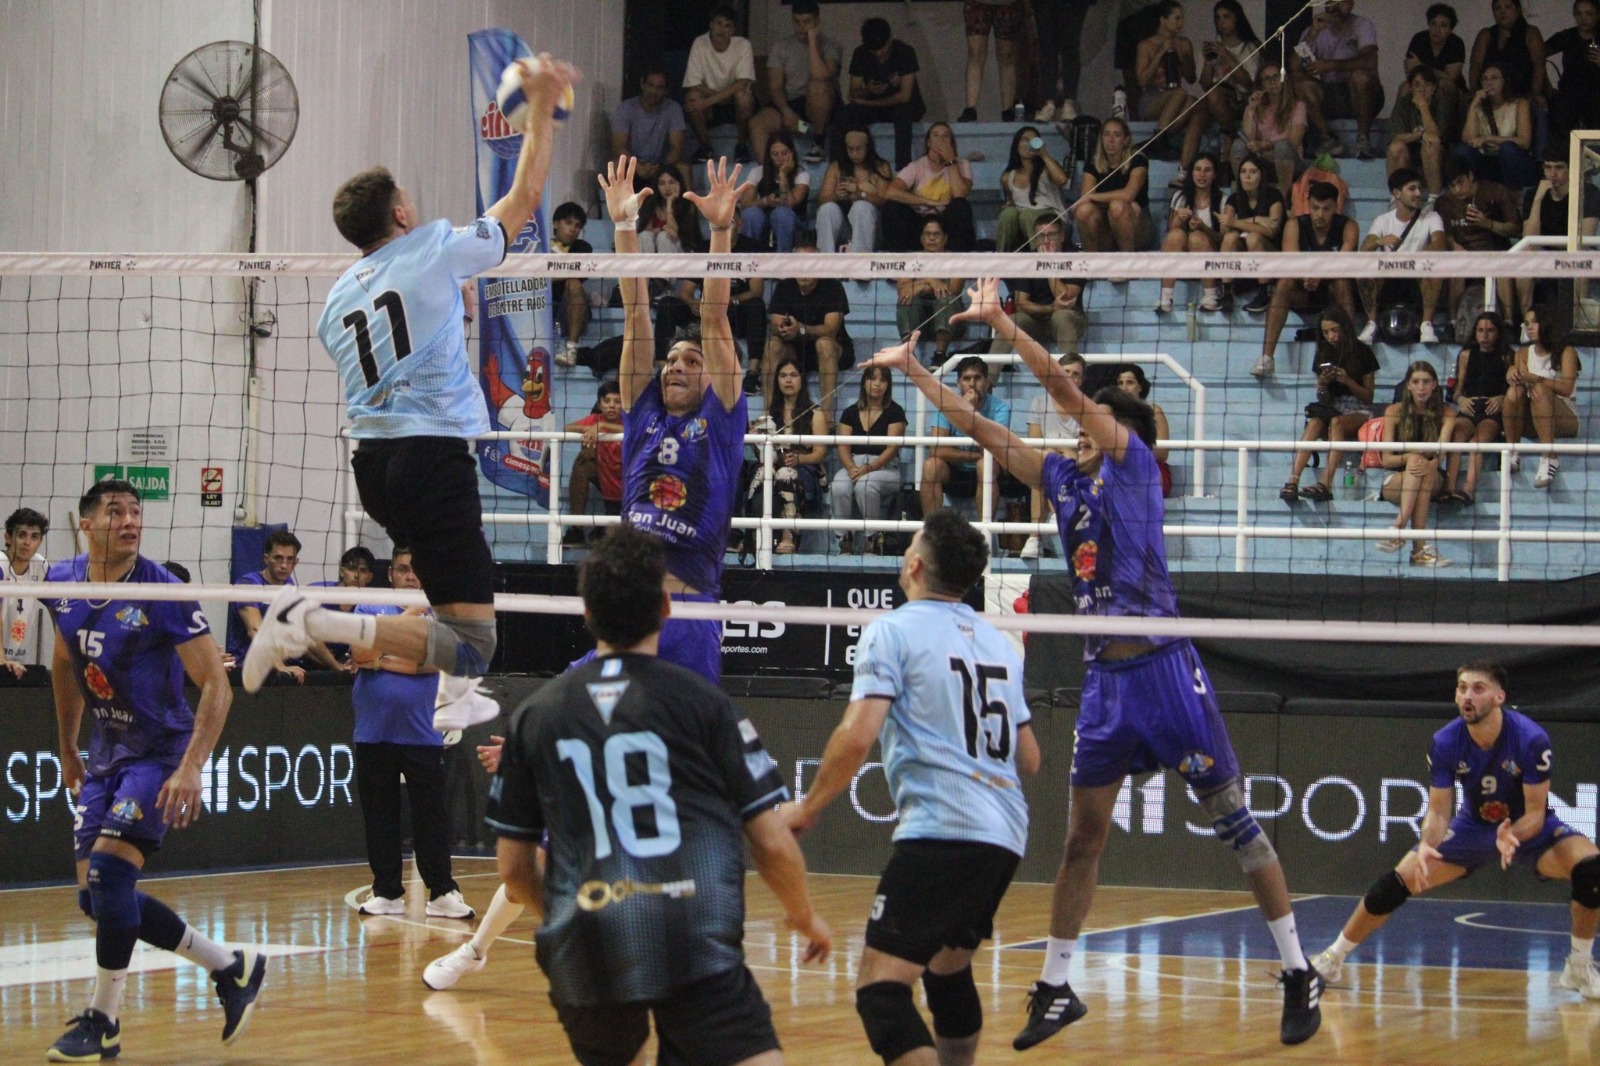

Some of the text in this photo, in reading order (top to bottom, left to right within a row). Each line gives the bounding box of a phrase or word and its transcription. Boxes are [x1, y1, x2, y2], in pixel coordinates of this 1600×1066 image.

[89, 260, 121, 270] PINTIER
[238, 260, 271, 270] PINTIER
[547, 261, 581, 271] PINTIER
[706, 261, 742, 271] PINTIER
[870, 261, 906, 271] PINTIER
[1036, 261, 1073, 271] PINTIER
[1204, 260, 1242, 271] PINTIER
[1377, 260, 1416, 271] PINTIER
[1554, 259, 1592, 270] PINTIER
[485, 277, 548, 300] EMBOTELLADORA
[497, 299, 524, 316] ENTRE
[342, 290, 412, 389] 11
[657, 437, 680, 466] 8
[128, 476, 167, 490] SALIDA
[656, 513, 697, 538] Juan
[1075, 504, 1092, 531] 2
[848, 588, 893, 610] QUE
[77, 629, 106, 658] 15
[720, 645, 768, 655] eportes.com
[950, 656, 1011, 764] 15
[1480, 775, 1497, 795] 9
[556, 731, 681, 859] 18
[871, 894, 887, 921] 5
